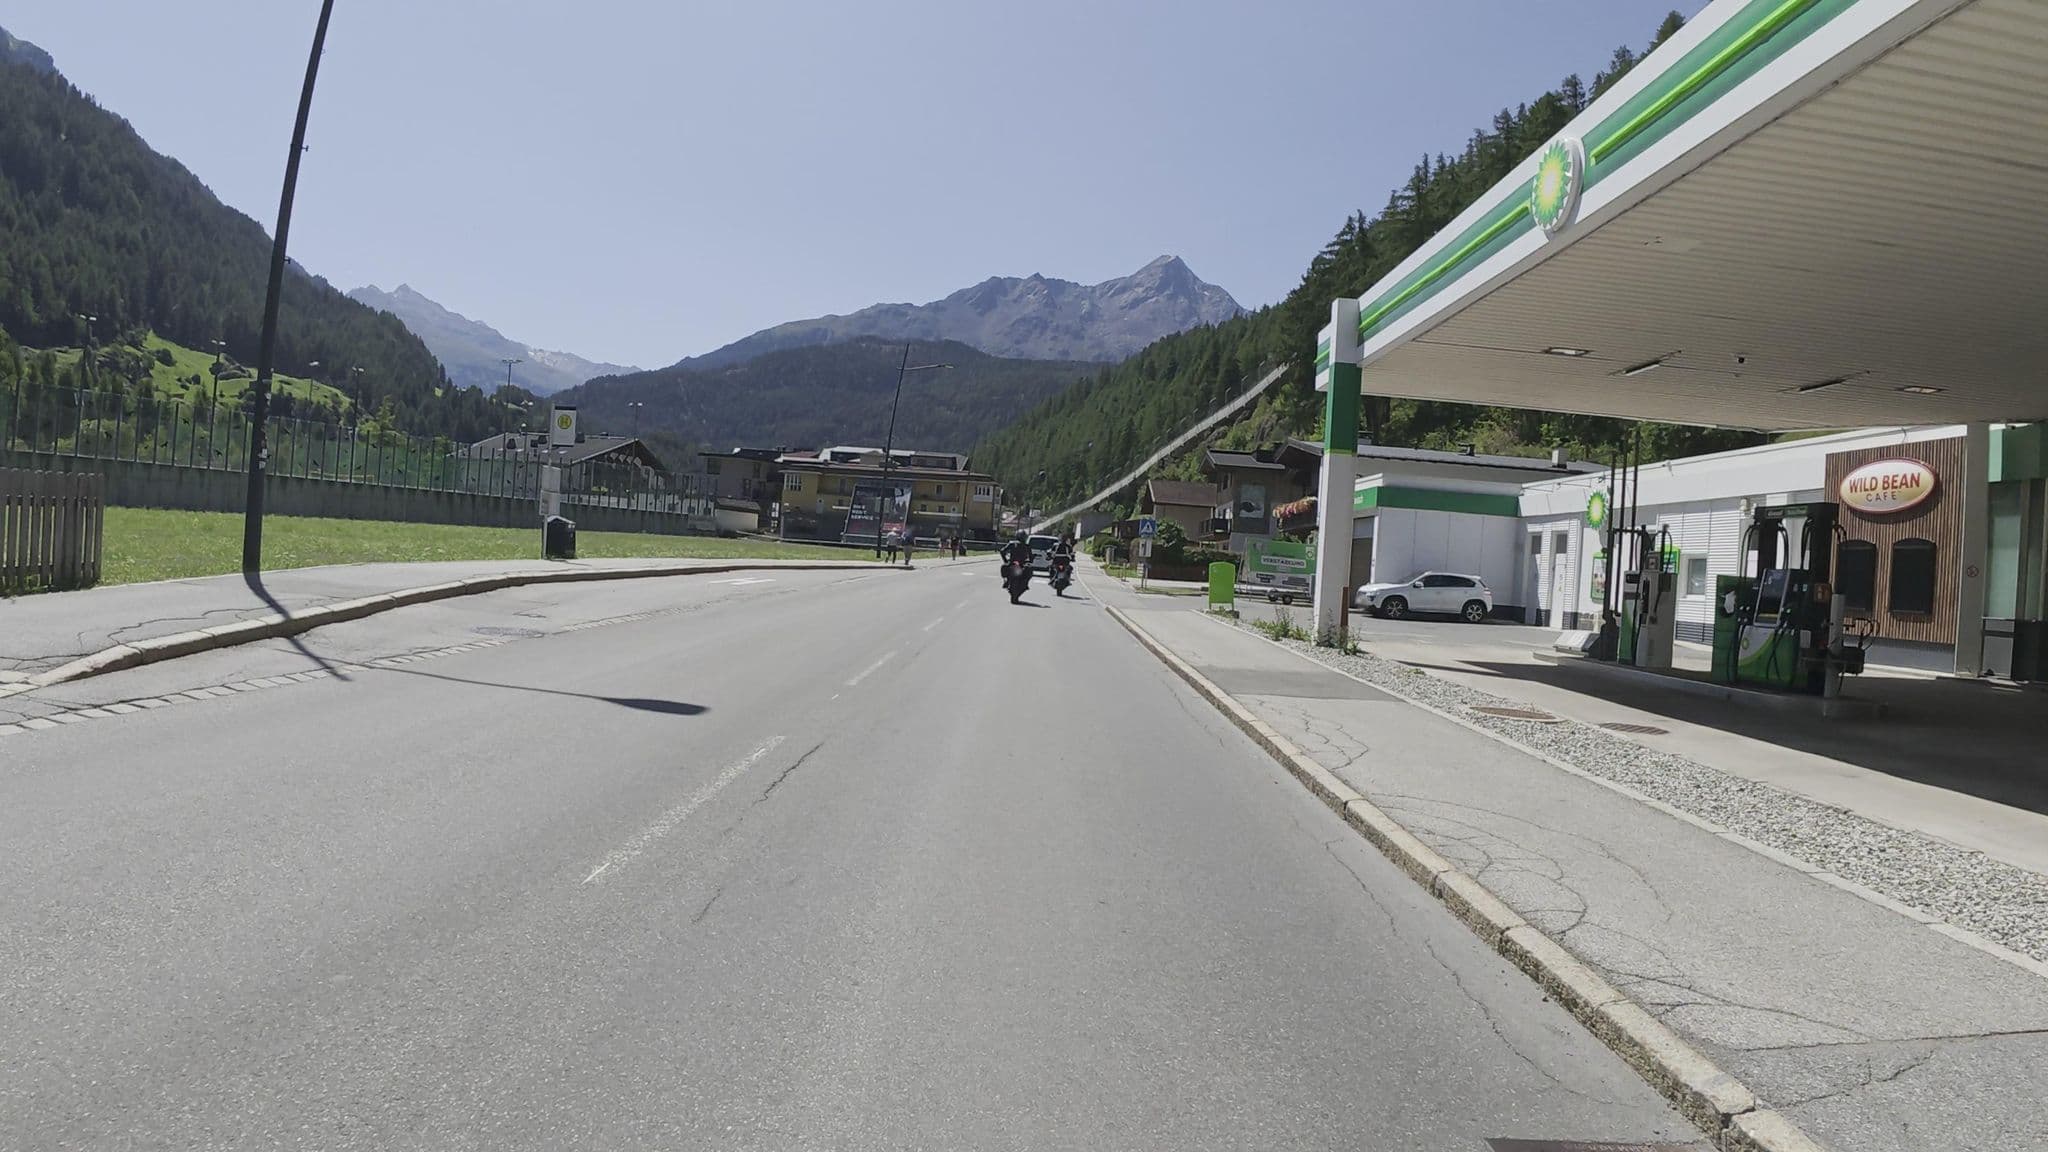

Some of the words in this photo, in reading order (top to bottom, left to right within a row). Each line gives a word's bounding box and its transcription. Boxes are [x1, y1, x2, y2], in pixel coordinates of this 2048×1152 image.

[1849, 476, 1878, 493] WILD
[1882, 472, 1921, 490] BEAN
[1866, 490, 1897, 502] CAFE
